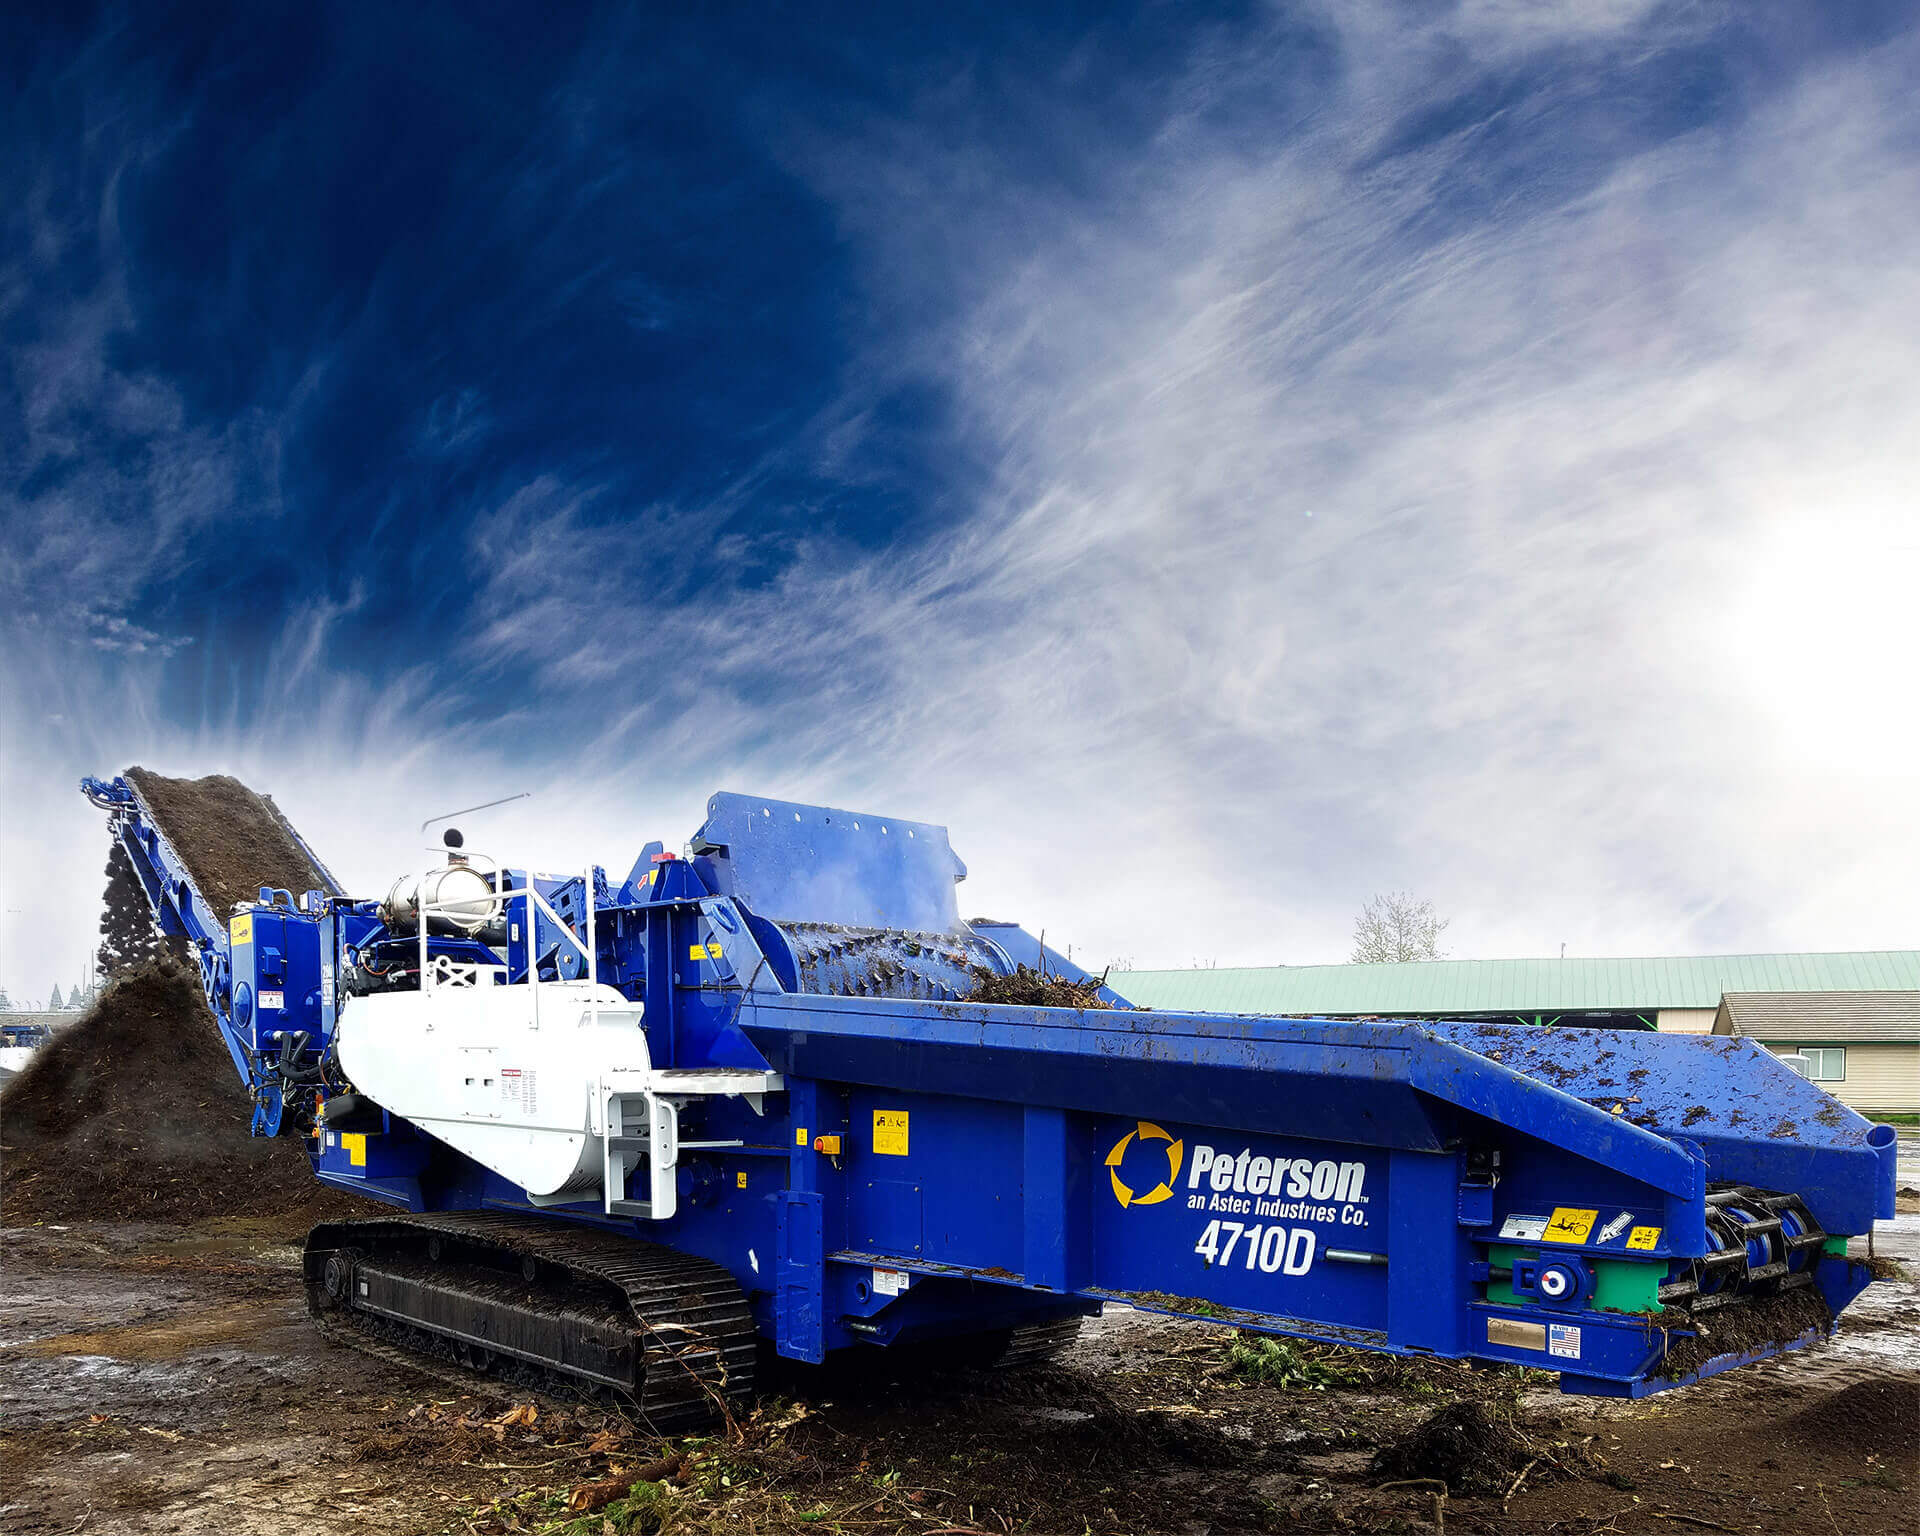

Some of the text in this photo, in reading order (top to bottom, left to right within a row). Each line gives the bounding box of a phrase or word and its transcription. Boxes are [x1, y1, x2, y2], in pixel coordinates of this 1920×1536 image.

[1188, 1145, 1366, 1203] Peterson
[1187, 1193, 1369, 1226] an Astec Industries Co.
[1195, 1220, 1317, 1276] 4710D
